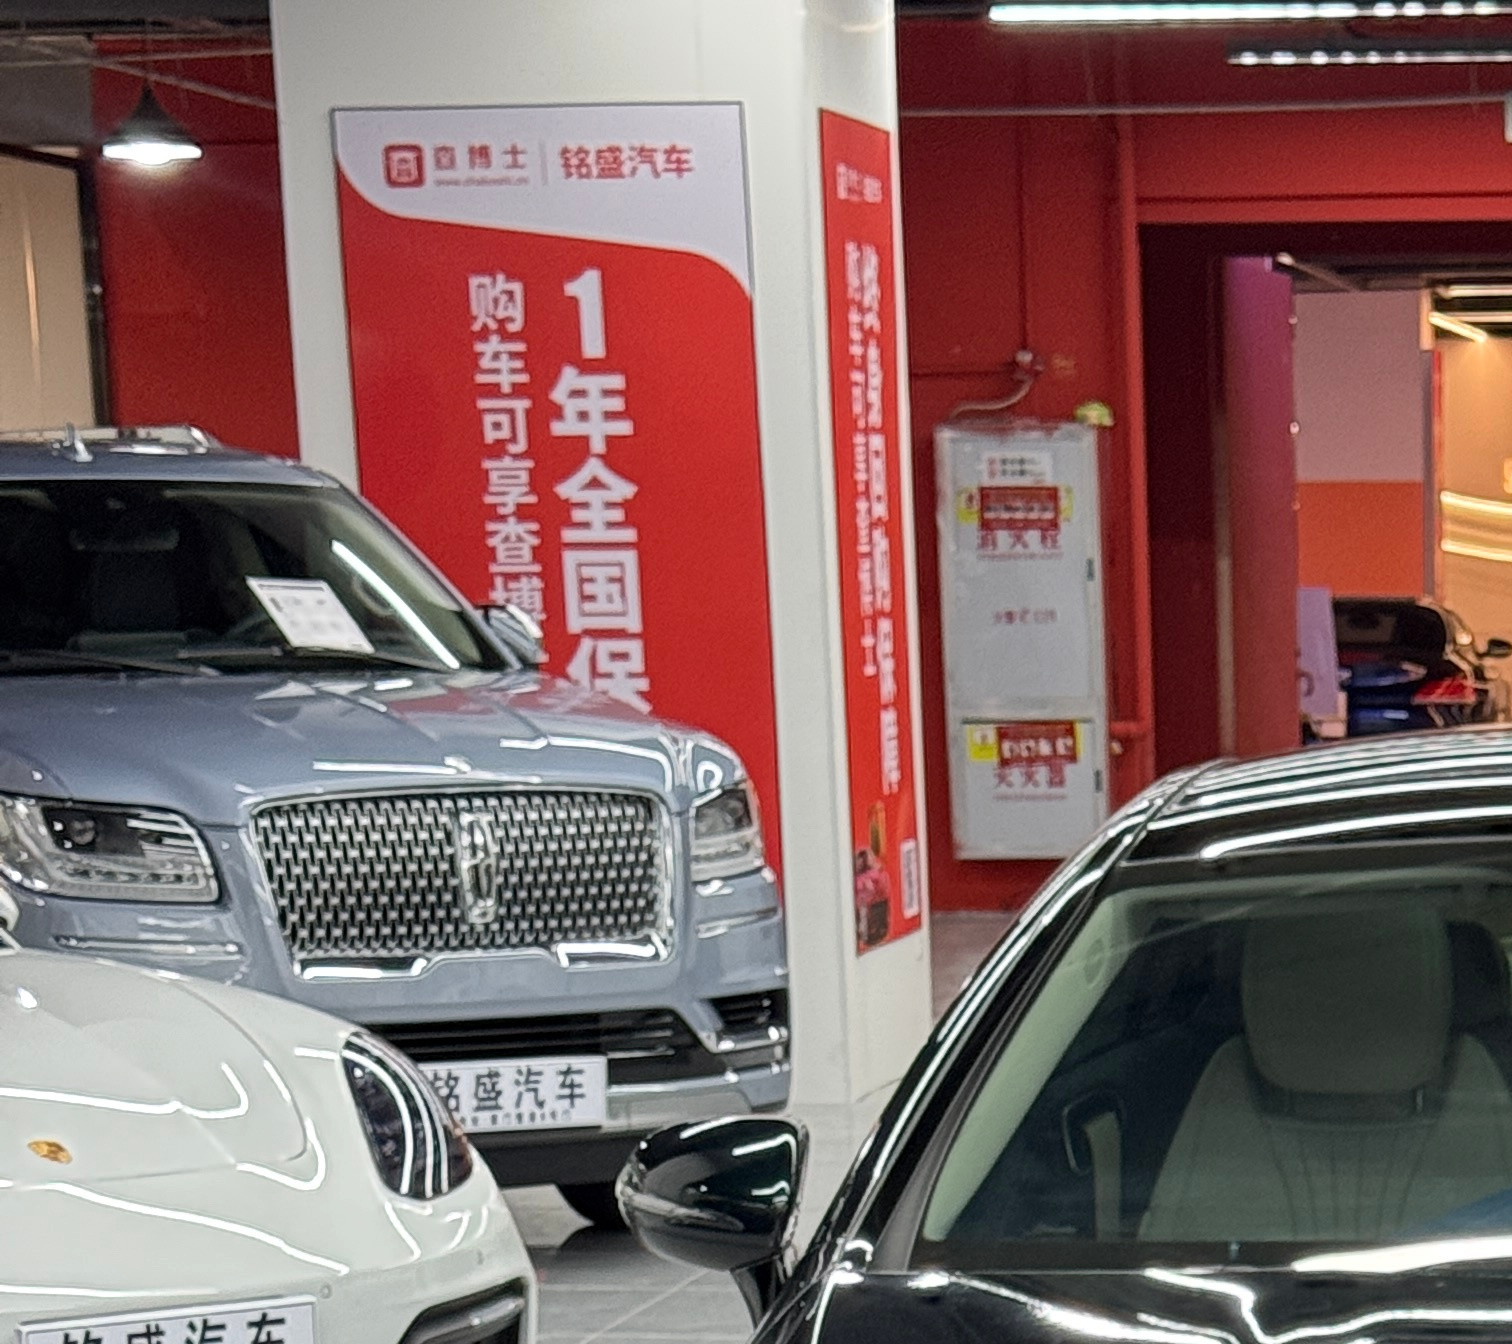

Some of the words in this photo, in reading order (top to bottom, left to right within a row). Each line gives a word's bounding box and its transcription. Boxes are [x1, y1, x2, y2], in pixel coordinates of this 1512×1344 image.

[560, 143, 694, 180] 铭盛汽车
[468, 273, 548, 663] 购车可享查博
[549, 268, 653, 714] 1年全国保
